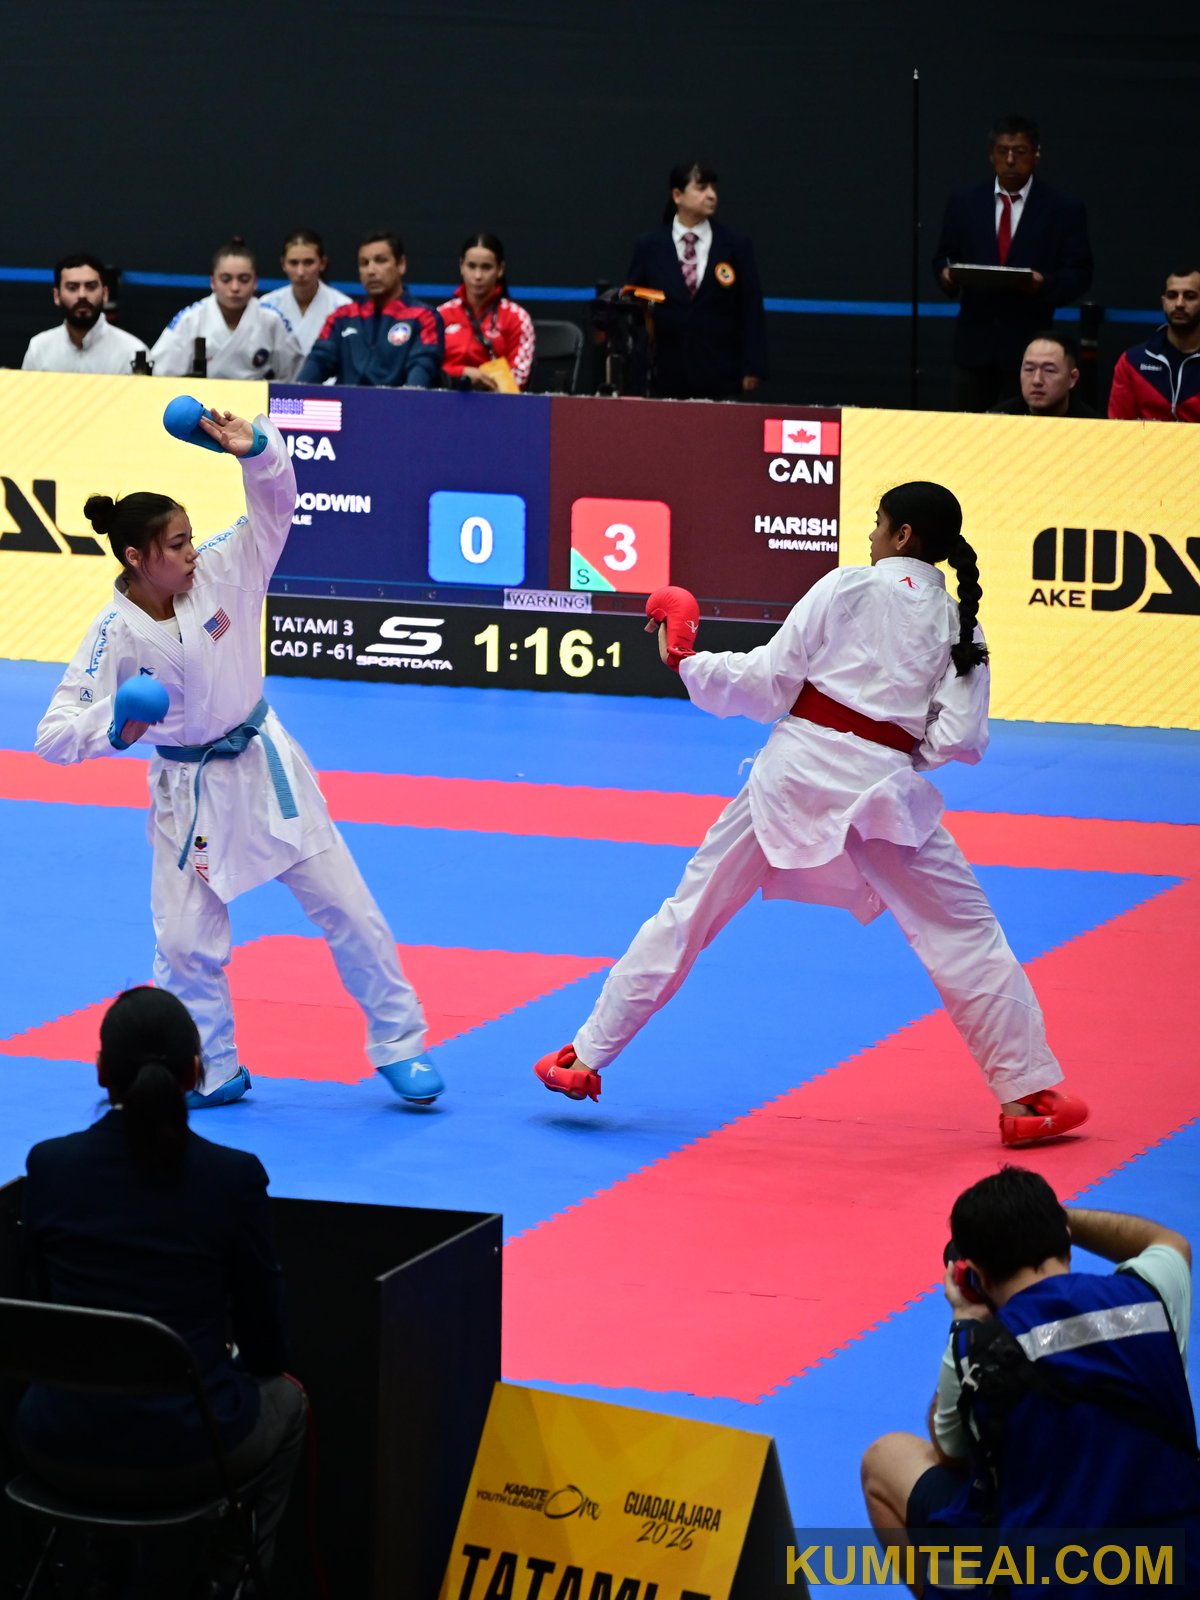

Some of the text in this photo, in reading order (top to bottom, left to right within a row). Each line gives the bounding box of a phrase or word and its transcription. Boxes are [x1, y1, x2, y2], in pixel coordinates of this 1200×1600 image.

[768, 457, 834, 485] CAN
[295, 492, 371, 514] ODWIN
[754, 514, 837, 537] HARISH
[459, 516, 494, 564] 0
[603, 523, 638, 571] 3
[576, 567, 590, 585] S
[1028, 588, 1086, 608] AKE
[272, 616, 354, 637] TATAMI 3
[270, 640, 354, 661] CAD F -61
[355, 655, 453, 671] SPORTDATA
[476, 1490, 545, 1513] YOUTH LEAGUE
[503, 1482, 550, 1501] KARATE
[623, 1491, 722, 1532] GUADALAJARA
[636, 1521, 696, 1551] 2026
[458, 1543, 659, 1600] TATA
